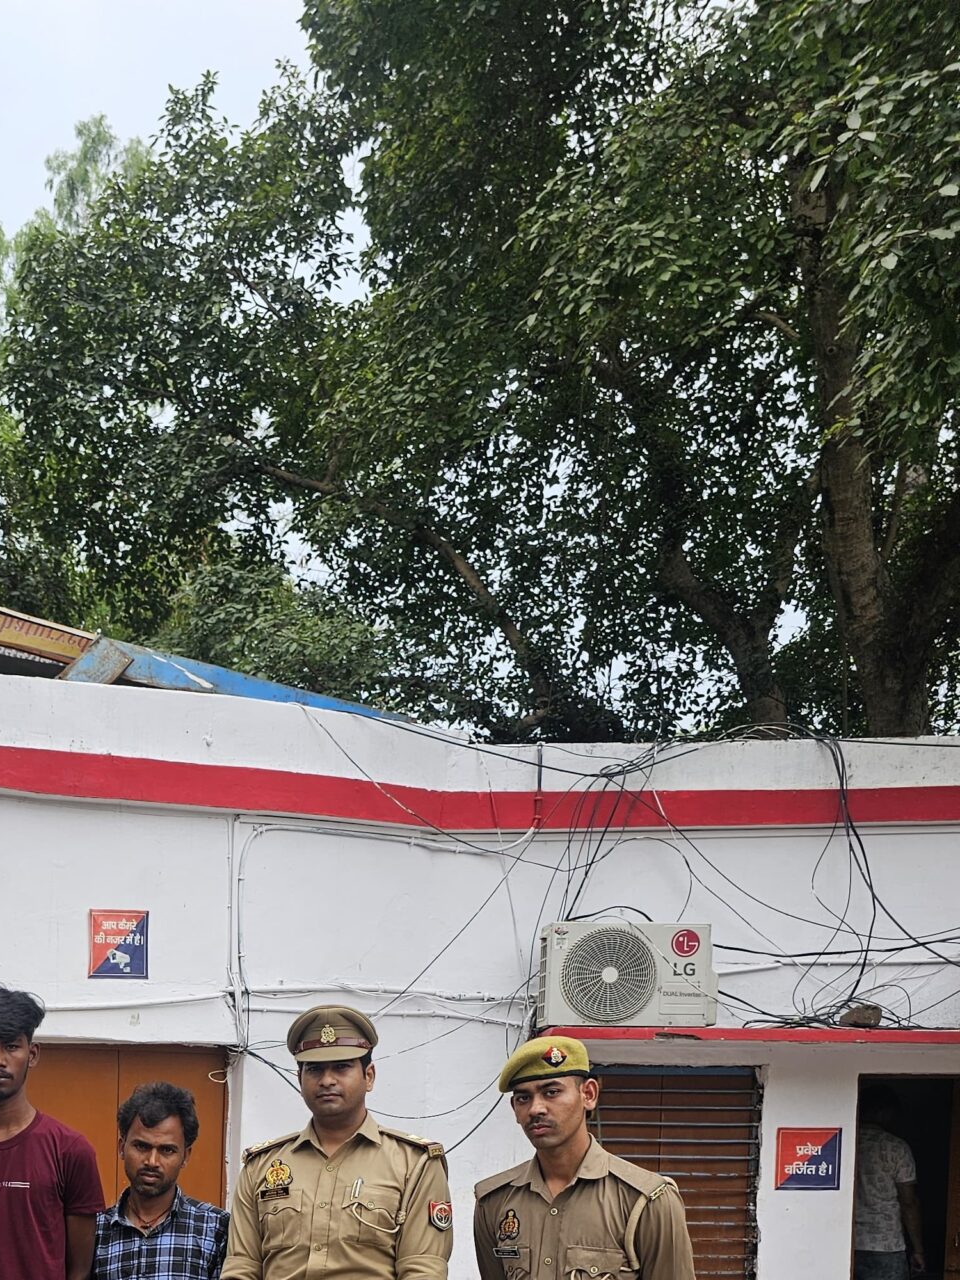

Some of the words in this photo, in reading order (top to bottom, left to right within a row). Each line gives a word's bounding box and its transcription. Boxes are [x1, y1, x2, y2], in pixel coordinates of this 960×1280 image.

[673, 962, 696, 976] LG
[796, 1142, 822, 1157] प्रवेश
[784, 1161, 816, 1175] वर्जित
